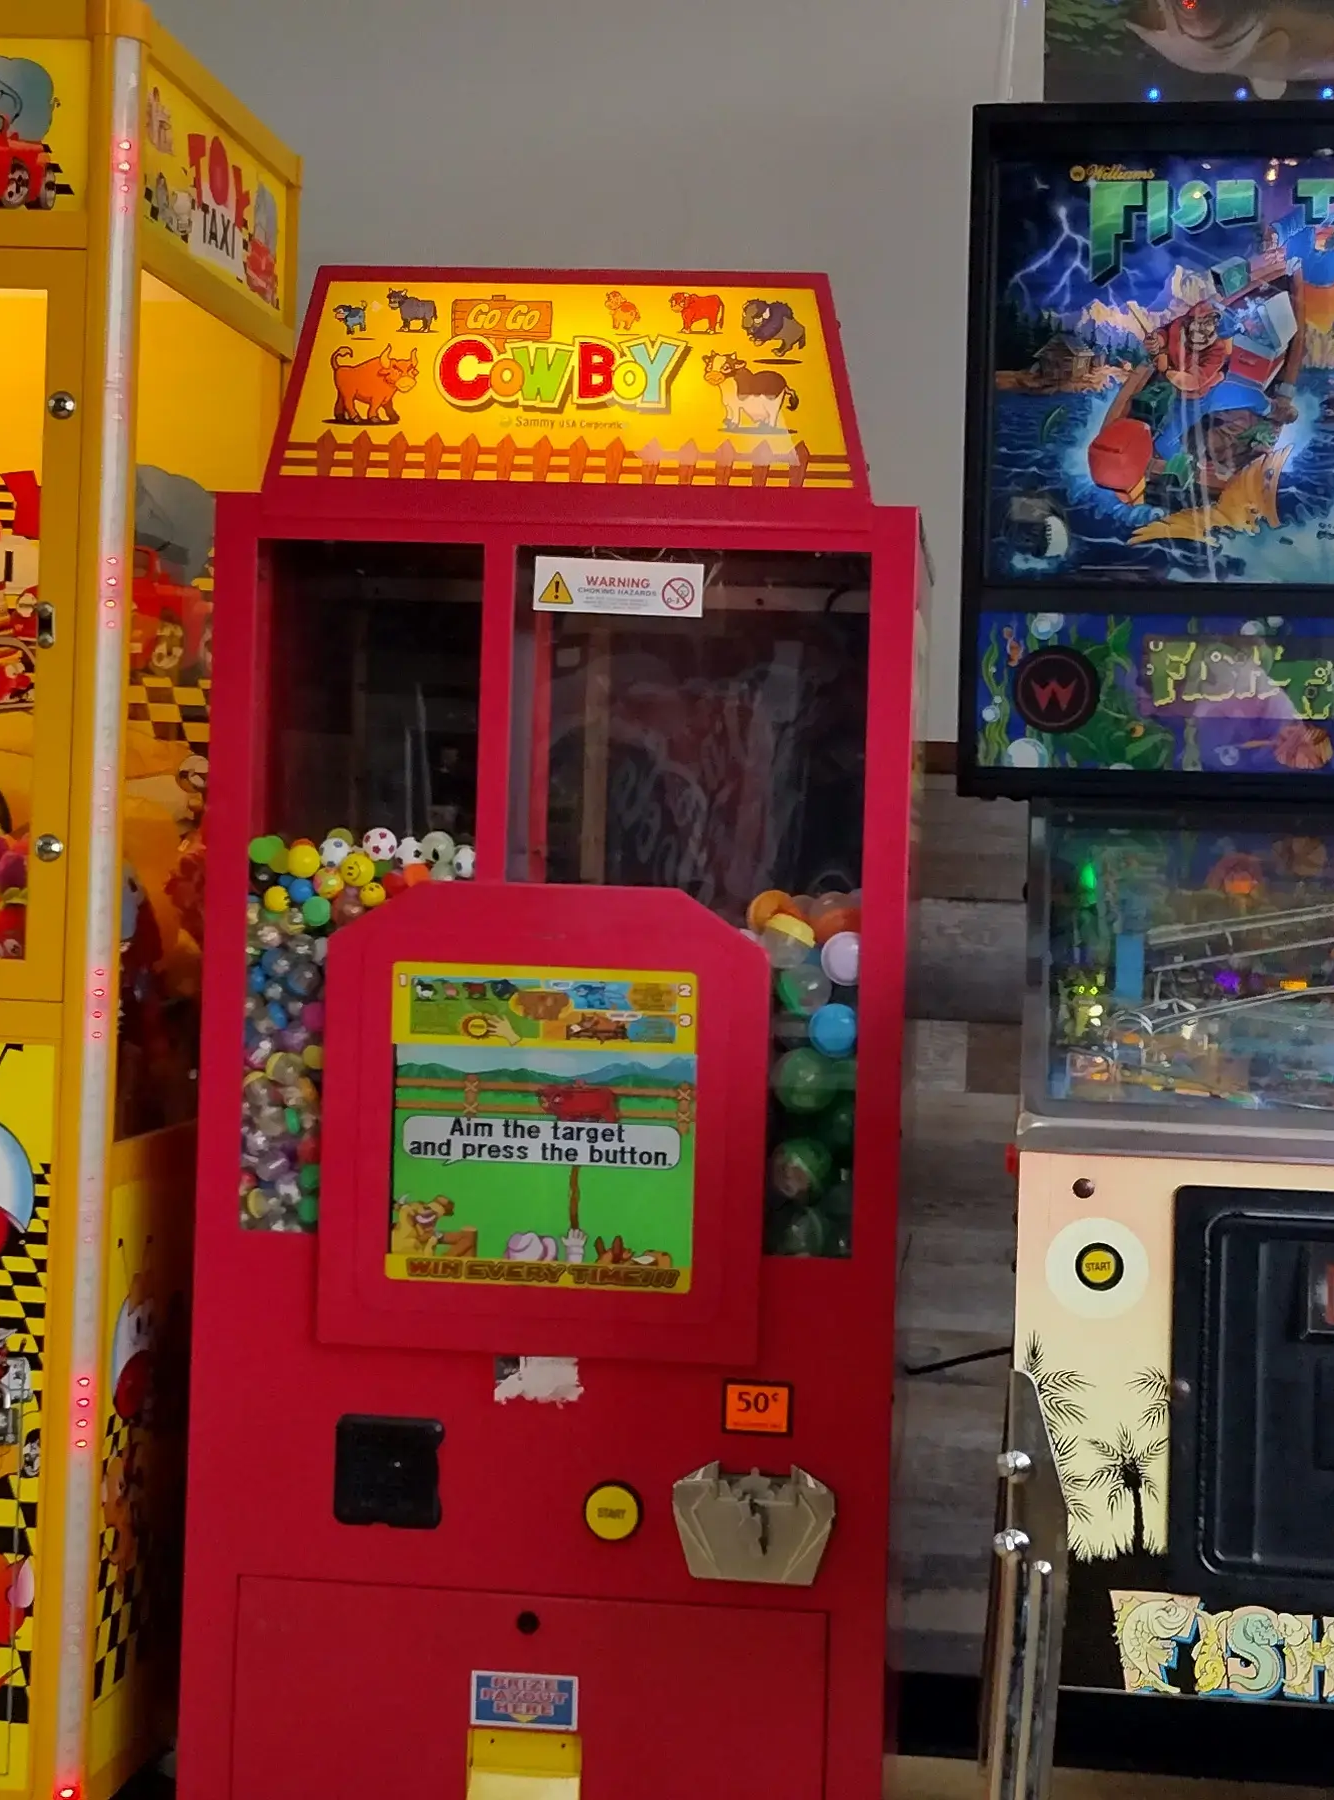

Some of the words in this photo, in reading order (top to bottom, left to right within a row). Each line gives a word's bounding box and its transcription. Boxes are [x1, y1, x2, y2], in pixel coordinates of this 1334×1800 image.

[1087, 164, 1155, 180] Williams
[188, 133, 250, 231] TOY
[201, 202, 235, 260] TAXI
[1089, 179, 1261, 289] FISH
[515, 416, 555, 430] Sammy
[559, 420, 577, 429] USA
[585, 575, 651, 589] WARNING
[577, 587, 616, 596] CHOKING
[617, 589, 657, 598] HAZARDS
[450, 1117, 493, 1137] Aim
[503, 1119, 541, 1139] the
[552, 1122, 625, 1143] target
[409, 1138, 452, 1157] and
[462, 1143, 529, 1160] press
[542, 1145, 579, 1163] the
[589, 1148, 673, 1167] button.
[406, 1258, 463, 1279] WIN
[466, 1261, 566, 1284] EVERY
[1084, 1260, 1112, 1273] START
[596, 1506, 628, 1520] START
[490, 1675, 559, 1692] PRIZE
[479, 1687, 569, 1705] PAYOUT
[492, 1700, 555, 1717] HERE
